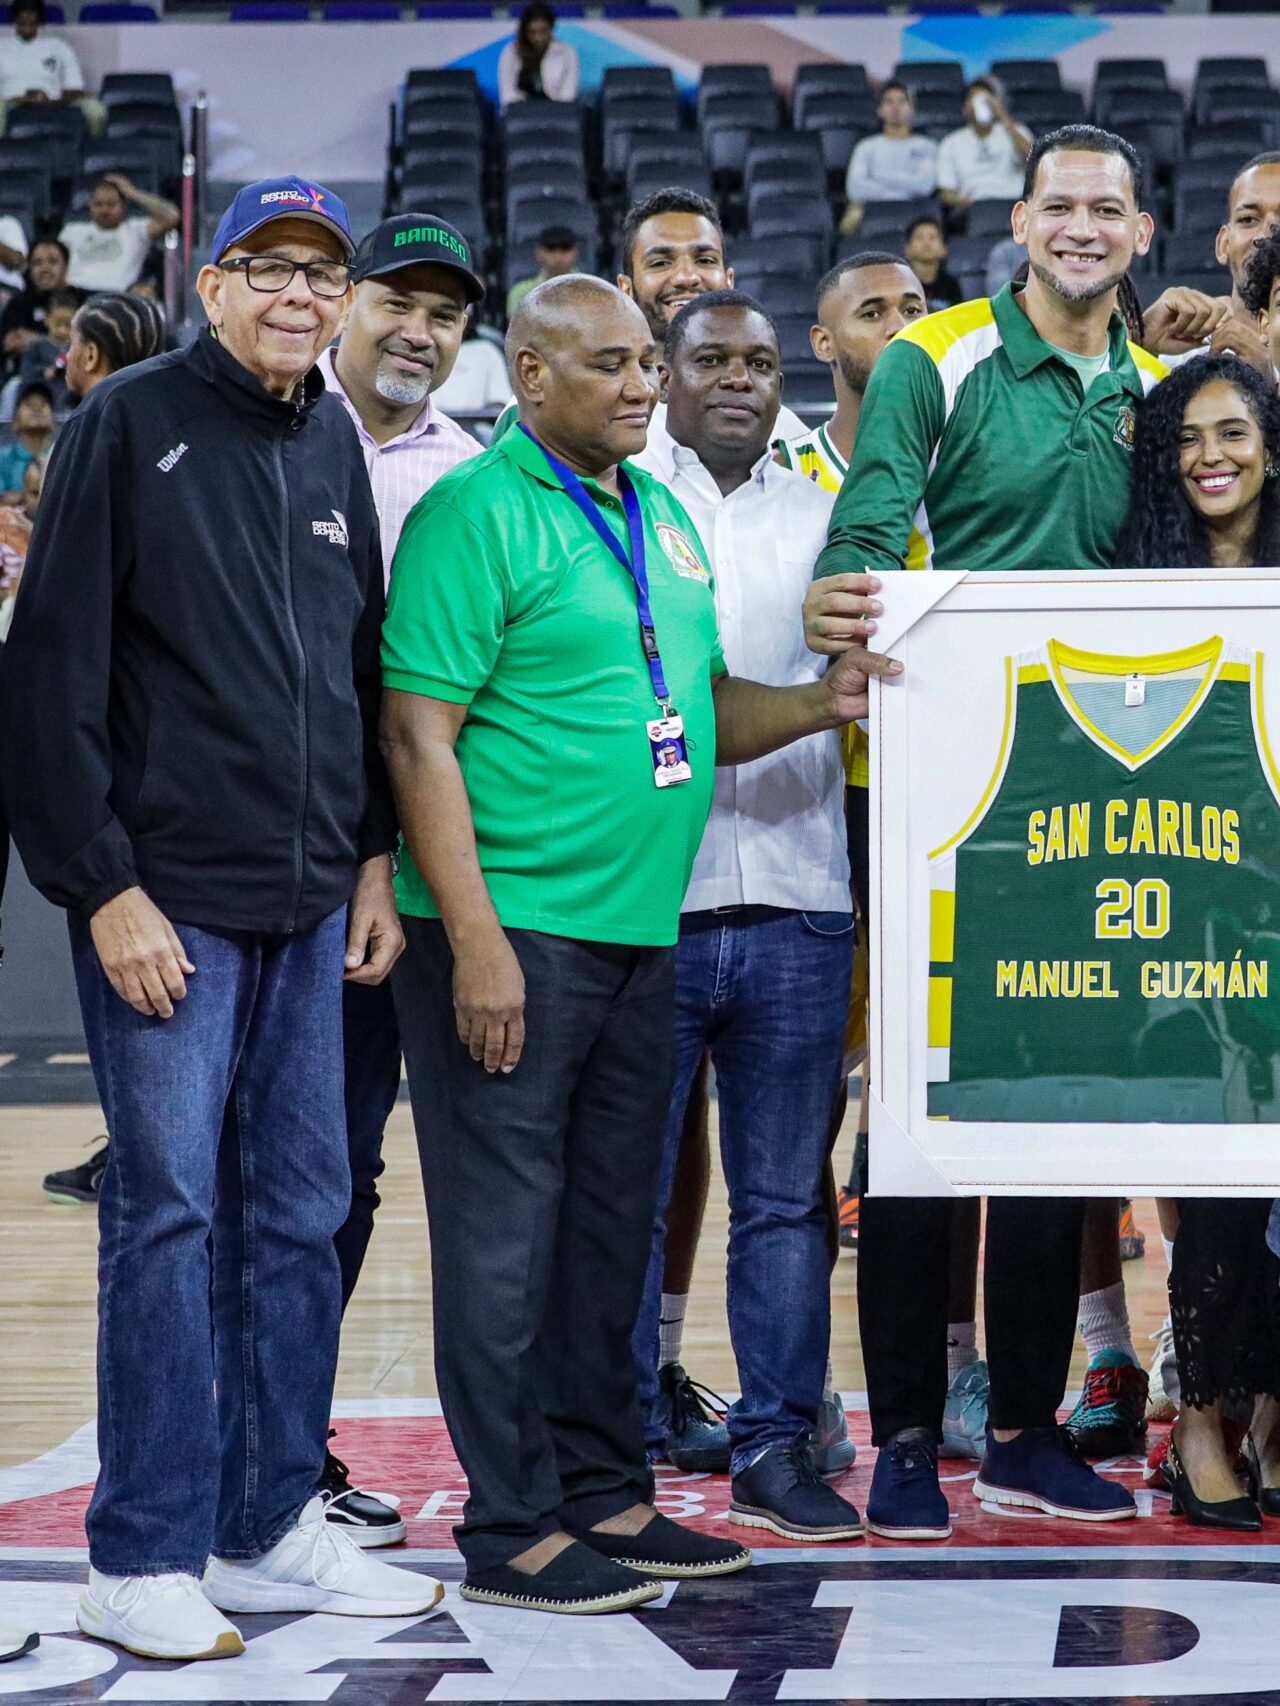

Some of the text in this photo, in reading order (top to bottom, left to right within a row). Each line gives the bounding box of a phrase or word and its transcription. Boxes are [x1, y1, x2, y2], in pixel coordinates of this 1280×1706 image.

[261, 191, 298, 200] SANTO
[261, 194, 309, 204] DOMINGO
[394, 227, 467, 263] BAMESO
[156, 442, 188, 472] Wilson
[311, 521, 340, 531] SANTO
[1027, 798, 1240, 865] SAN CARLOS
[1095, 878, 1170, 939] 20
[996, 949, 1268, 999] MANUEL GUZMÁN
